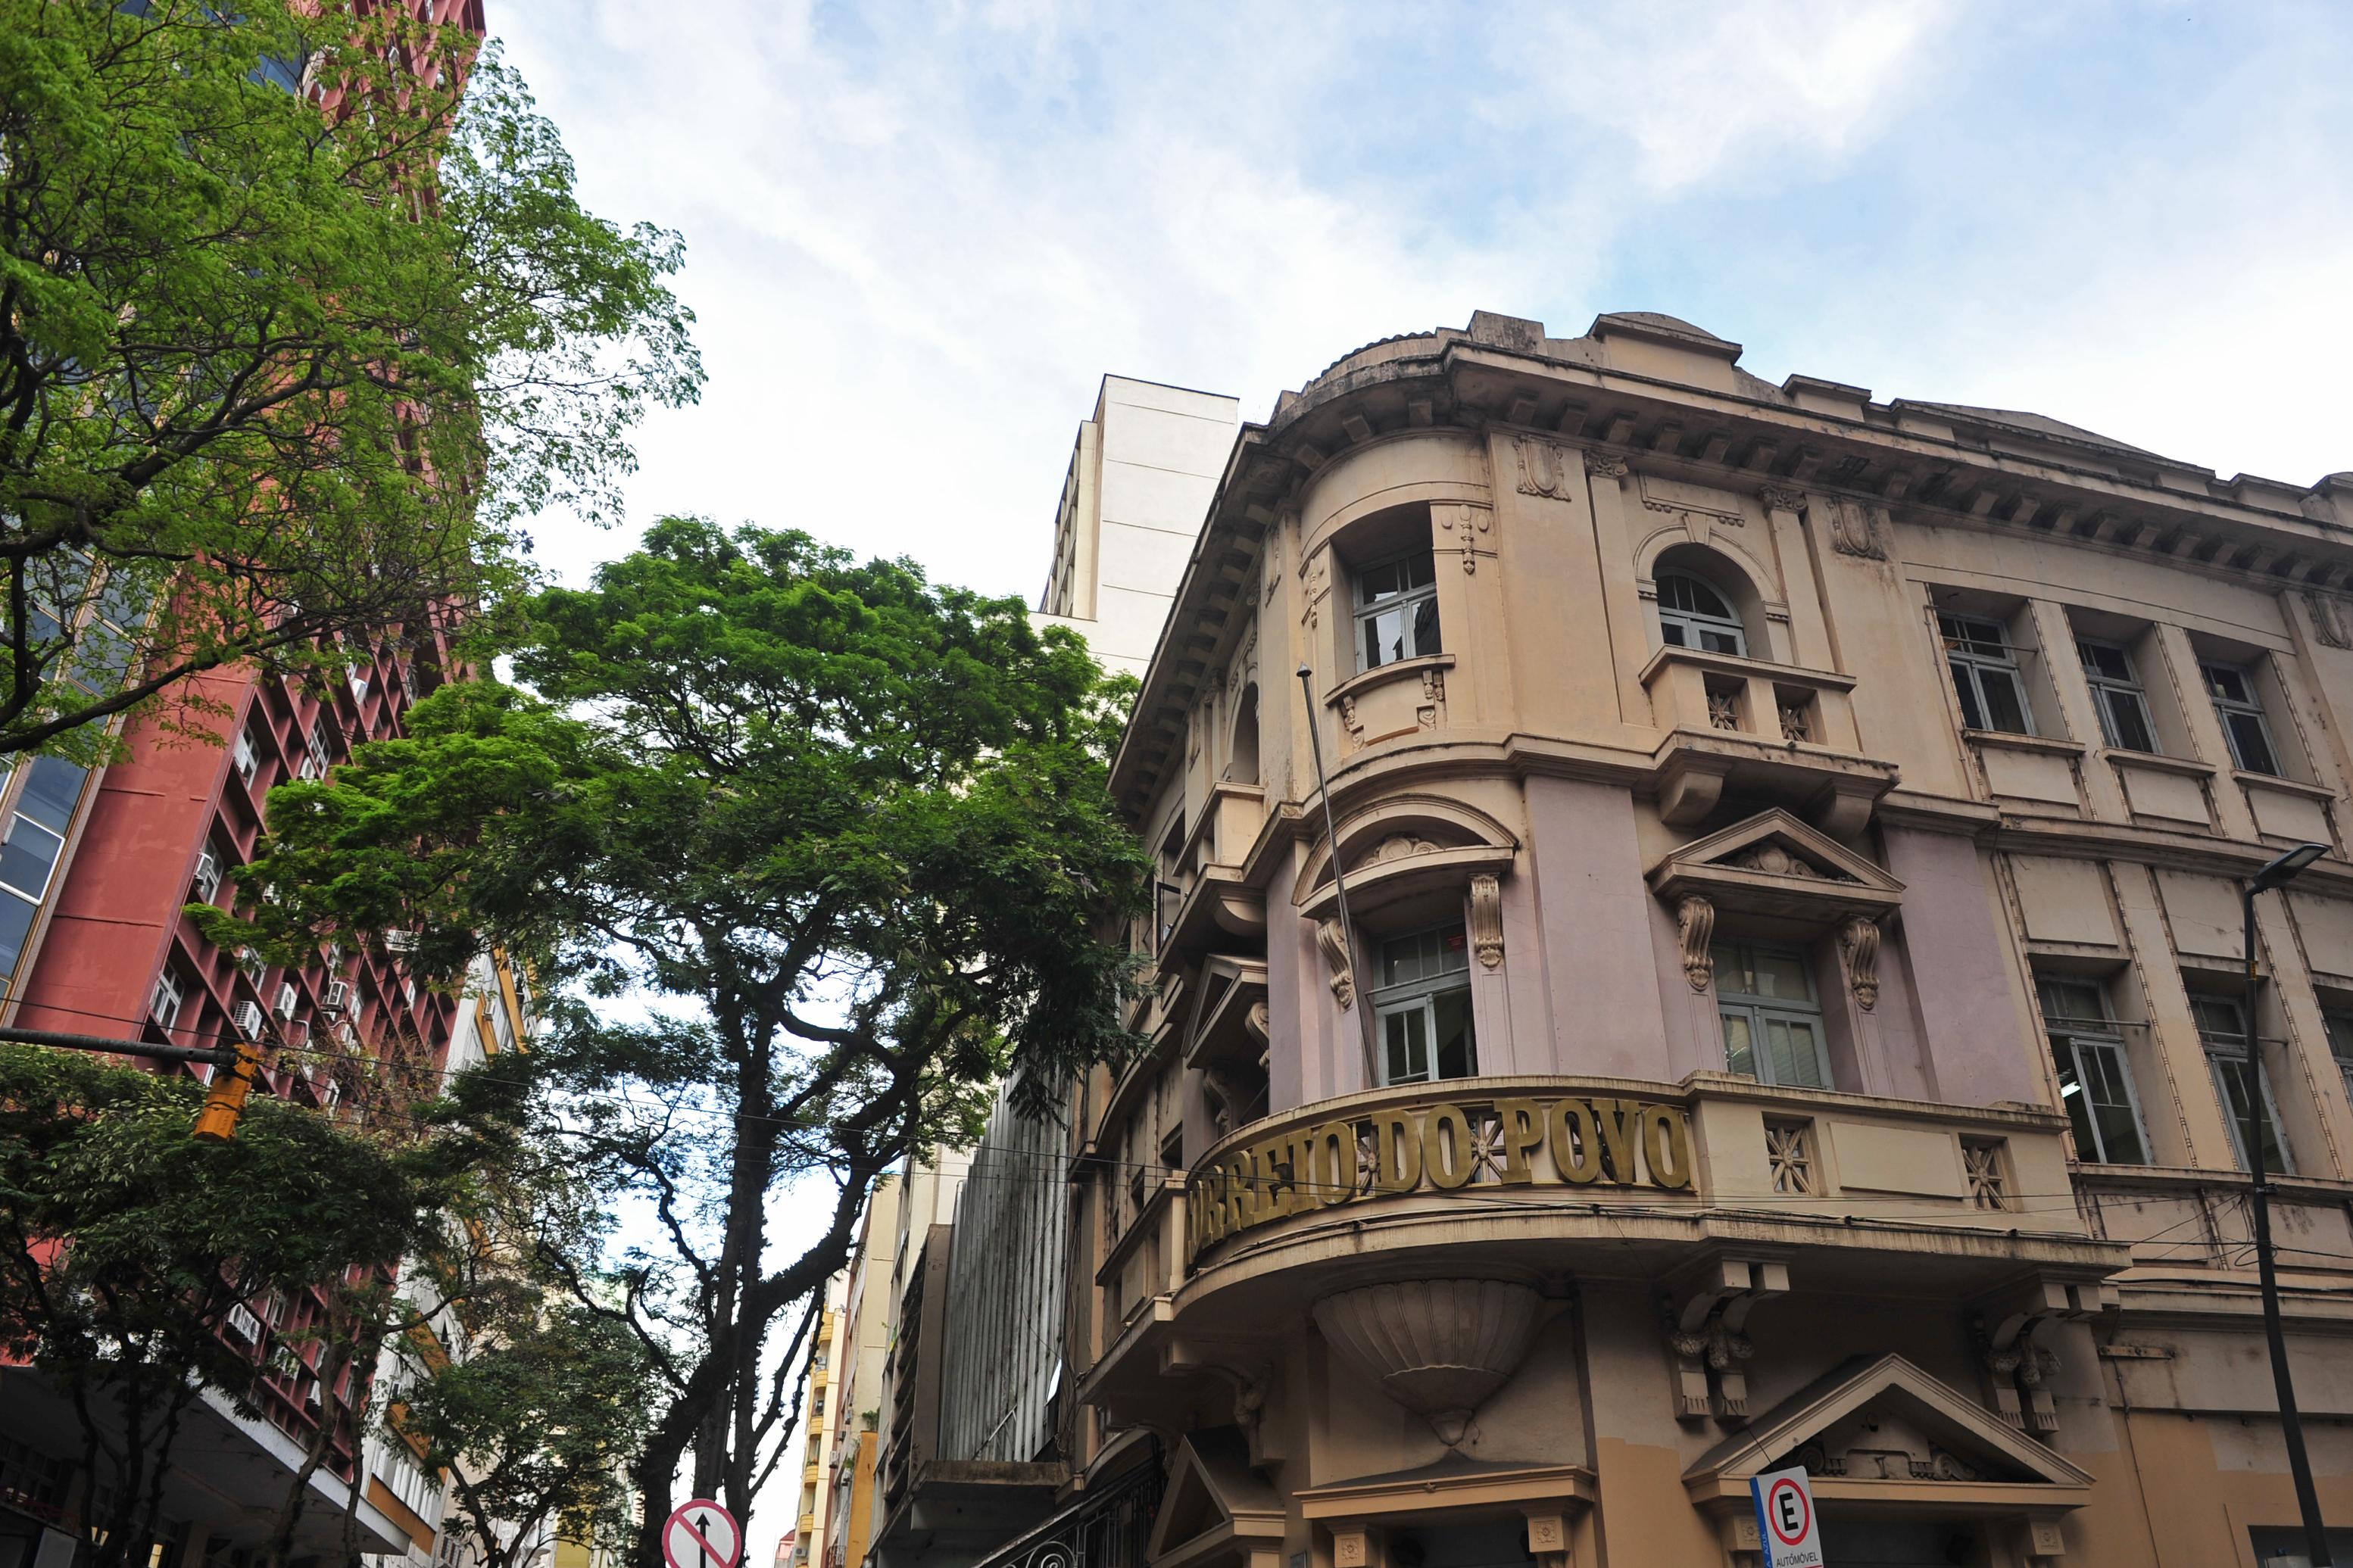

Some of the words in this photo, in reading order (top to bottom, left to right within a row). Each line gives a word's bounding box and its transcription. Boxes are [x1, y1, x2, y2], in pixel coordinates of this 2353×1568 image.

[1187, 1122, 1356, 1264] ORREIO
[1372, 1104, 1473, 1194] DO
[1493, 1098, 1690, 1189] POVO
[1779, 1492, 1799, 1531] E
